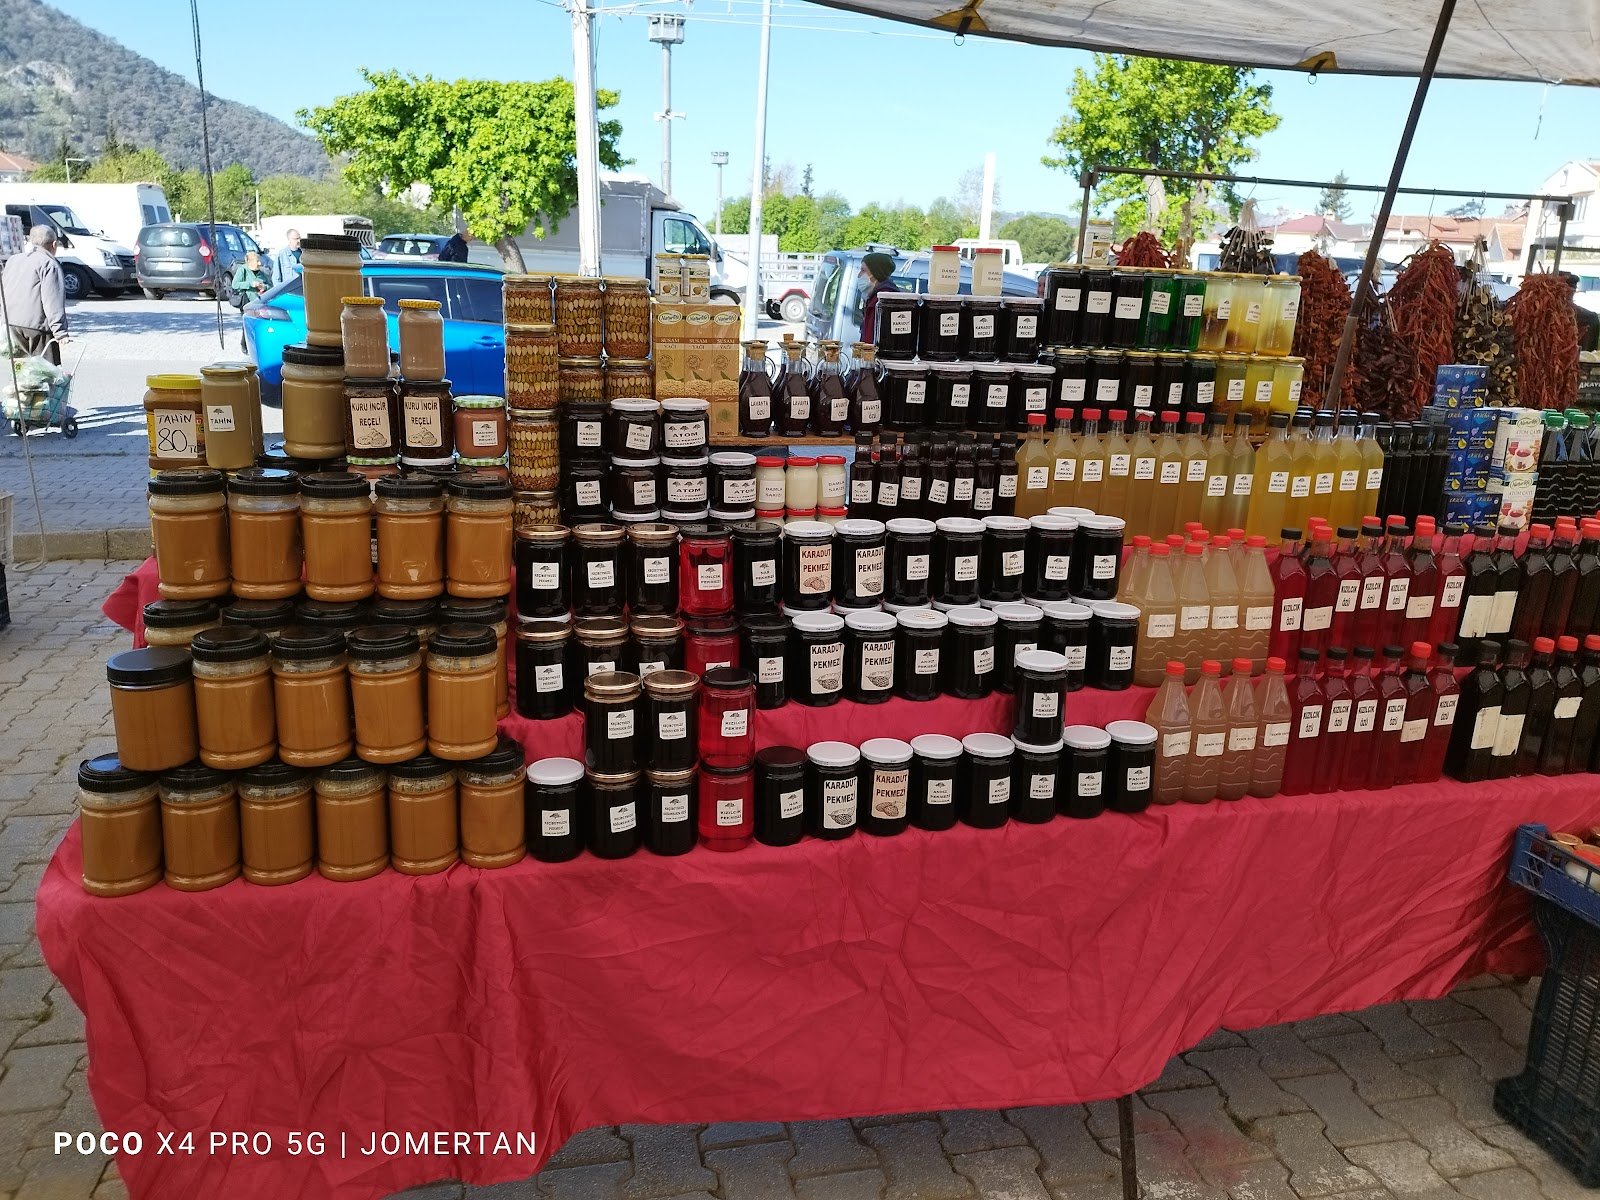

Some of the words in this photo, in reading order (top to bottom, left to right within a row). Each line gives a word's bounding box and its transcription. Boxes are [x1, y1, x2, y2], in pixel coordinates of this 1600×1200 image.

[352, 402, 368, 411] KURU
[405, 402, 420, 410] KURU
[360, 416, 381, 428] REÇELİ
[411, 416, 432, 427] REÇELİ
[158, 428, 188, 452] 80
[801, 549, 831, 558] KARADUT
[857, 548, 883, 558] KARADUT
[812, 643, 842, 655] KARADUT
[864, 641, 893, 651] KARADUT
[826, 777, 857, 789] KARADUT
[877, 774, 907, 783] KARADUT
[827, 790, 855, 803] PEKMEZİ
